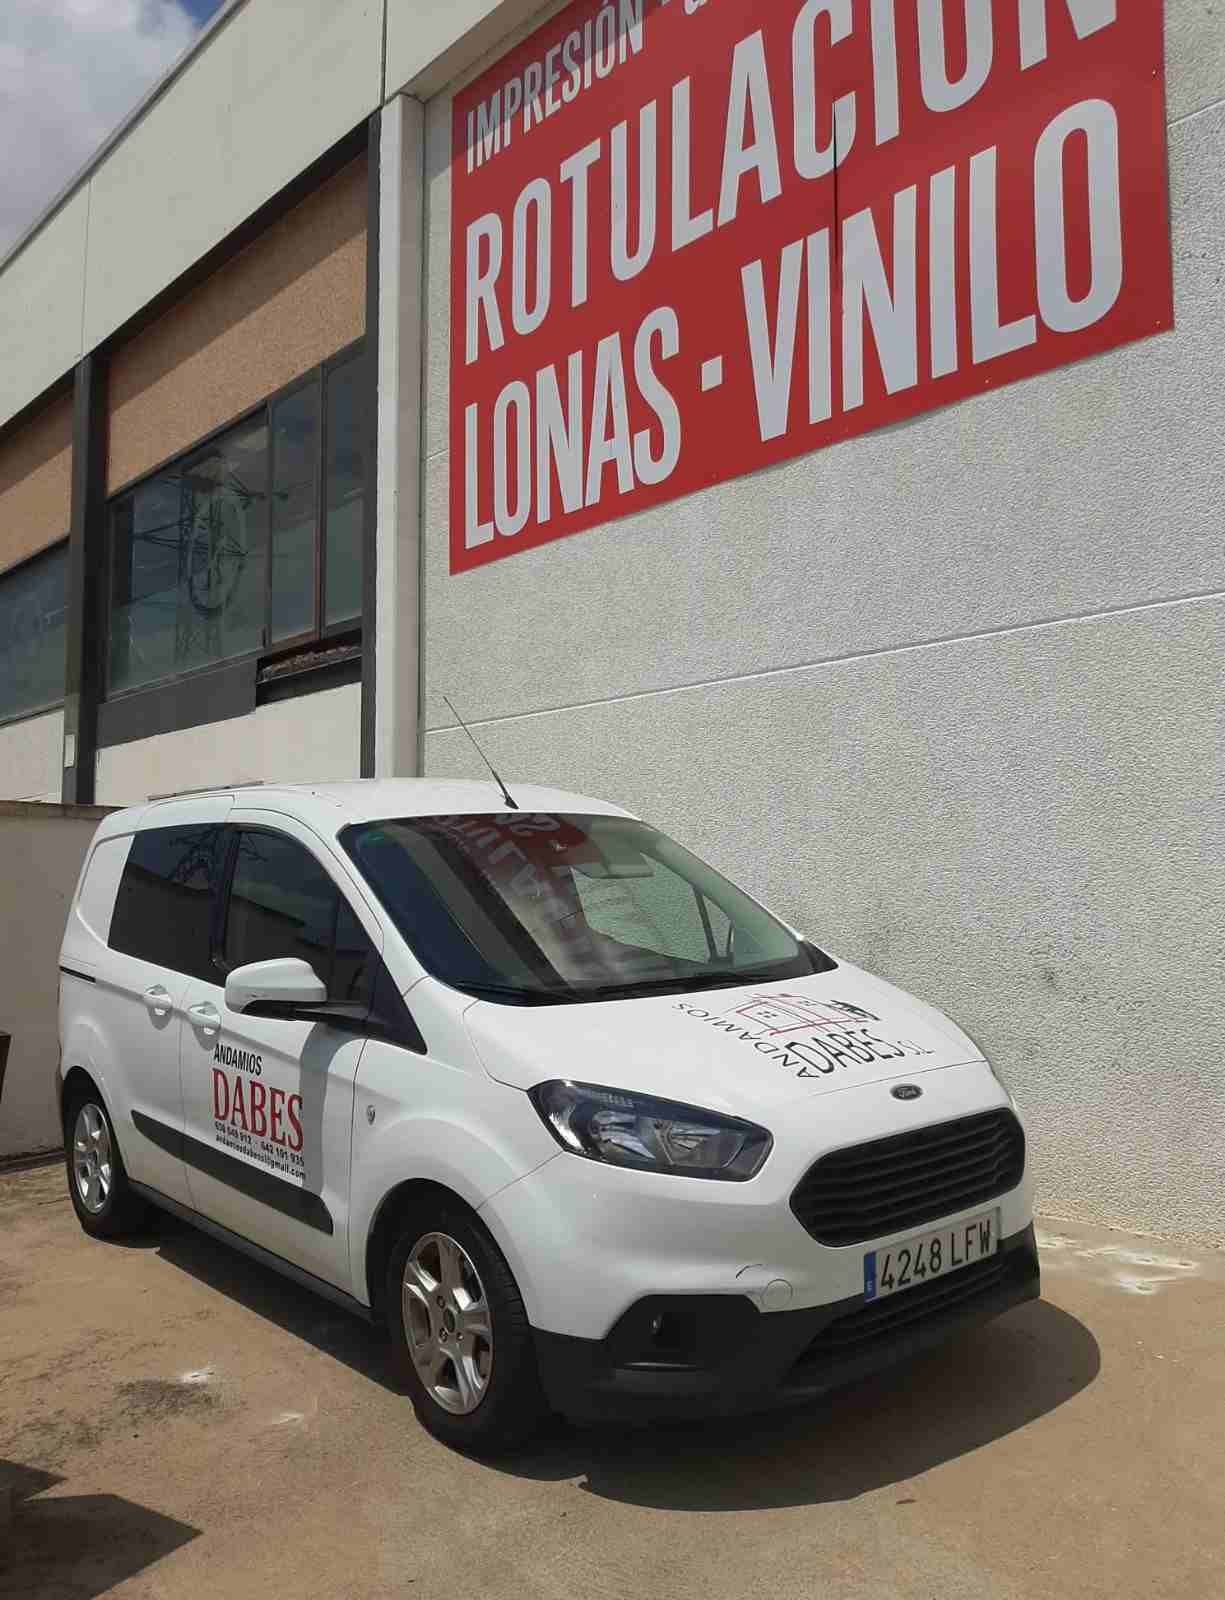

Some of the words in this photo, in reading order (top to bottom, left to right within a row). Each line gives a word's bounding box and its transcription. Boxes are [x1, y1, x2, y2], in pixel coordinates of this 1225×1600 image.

[464, 306, 682, 550] LONAS
[740, 98, 1123, 442] VINILO
[213, 1042, 263, 1076] ANDAMIOS
[672, 1002, 820, 1078] ANDAMIOS
[784, 1028, 906, 1074] DABES
[212, 1067, 304, 1152] DABES
[880, 1237, 943, 1291] 4248
[951, 1213, 991, 1267] LFW
